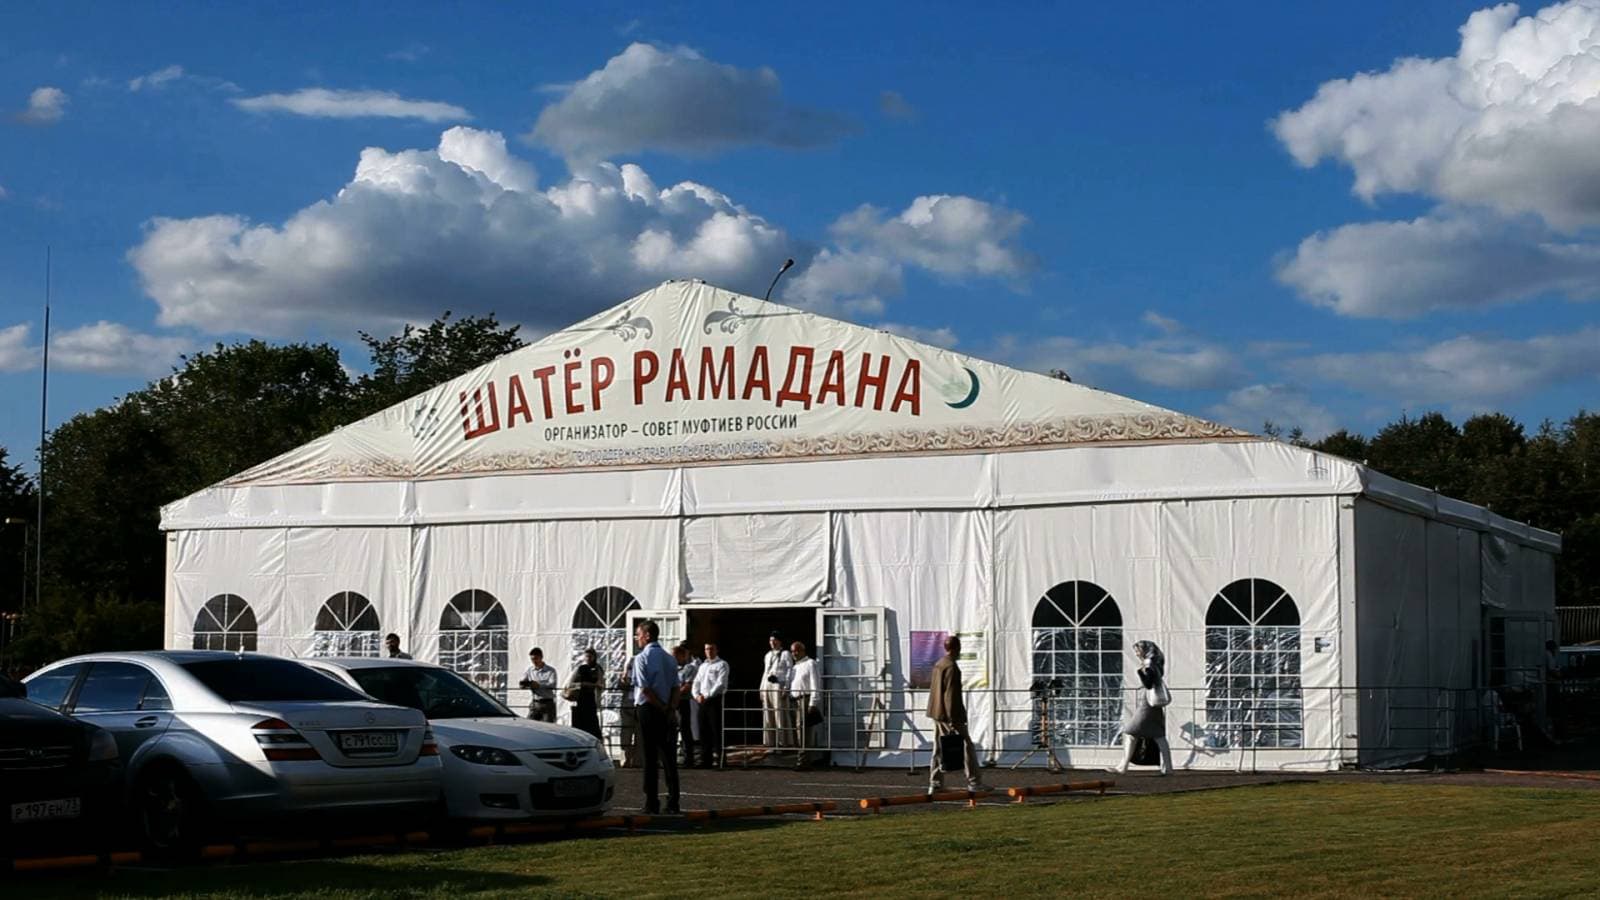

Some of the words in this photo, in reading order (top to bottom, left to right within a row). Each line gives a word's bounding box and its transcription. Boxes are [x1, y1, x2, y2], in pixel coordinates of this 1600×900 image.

[459, 347, 616, 441] ШАТЁР
[634, 346, 920, 416] РАМАДАНА
[544, 423, 628, 441] ОРГАНИЗАТОР
[642, 420, 680, 437] СОВЕТ
[682, 416, 743, 435] МУФТИЕВ
[746, 414, 798, 431] РОССИИ
